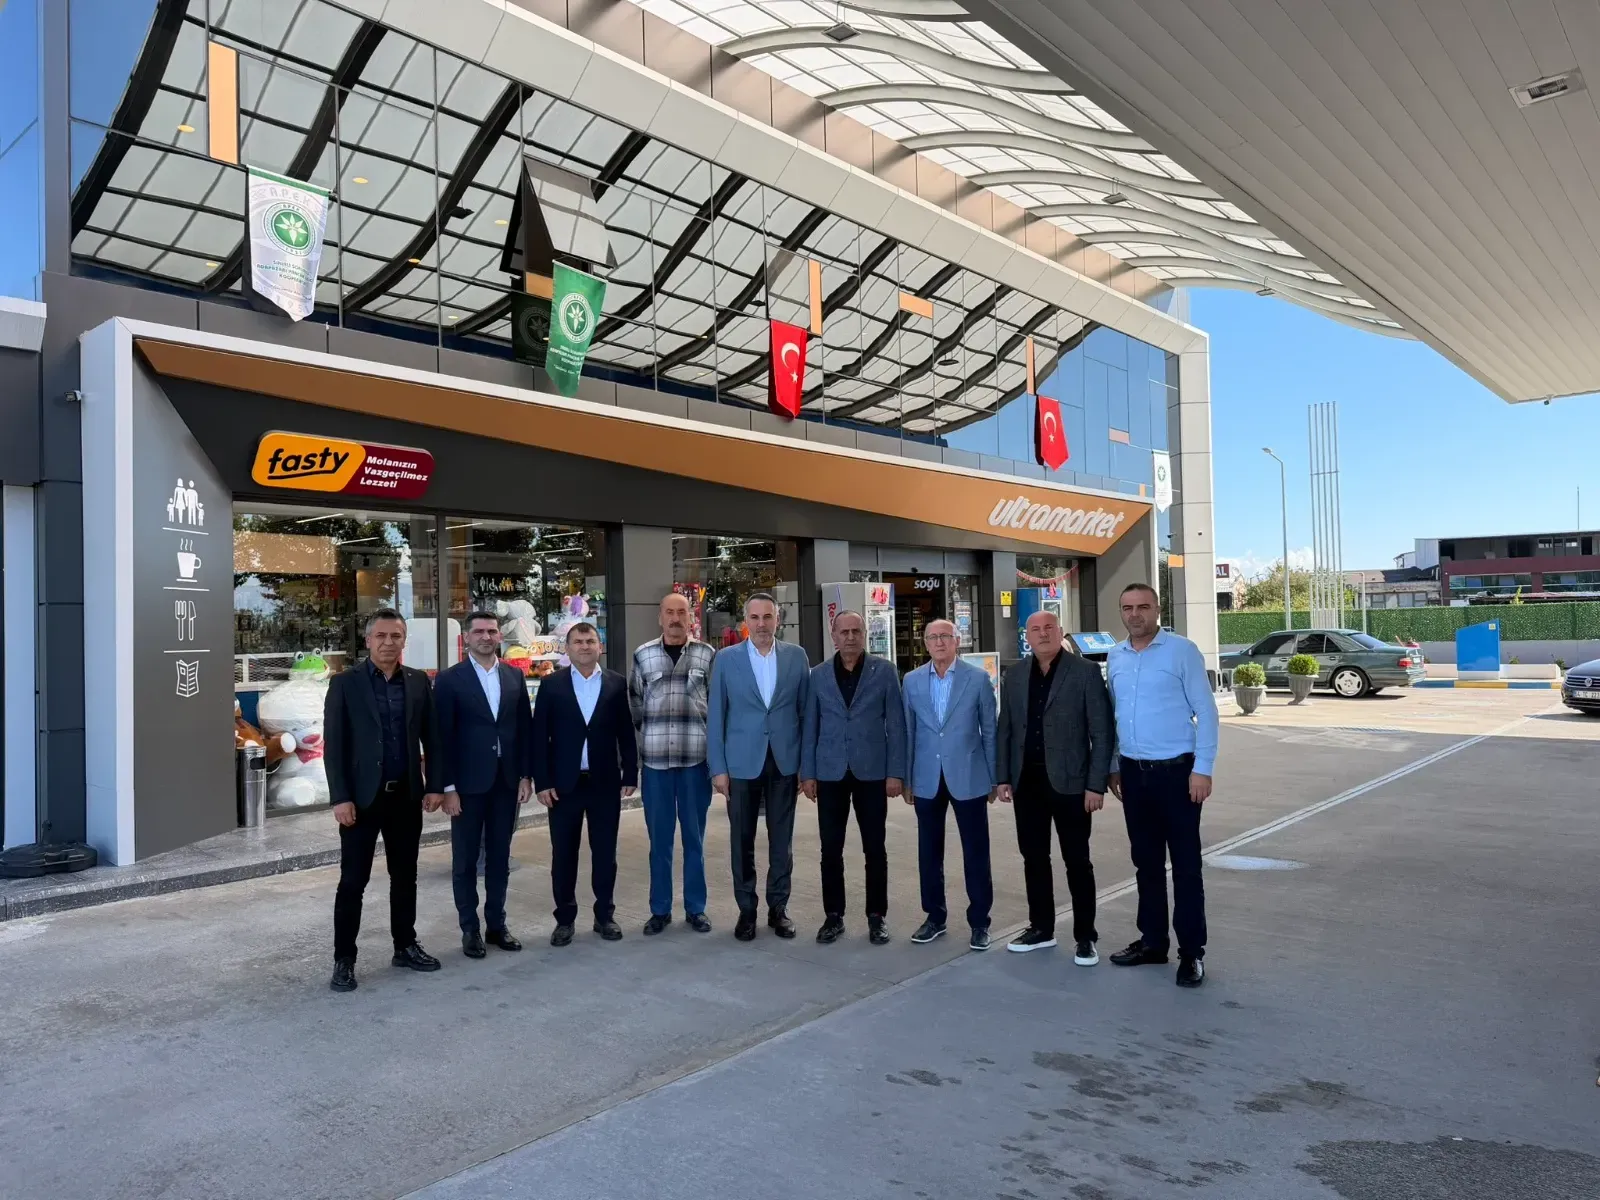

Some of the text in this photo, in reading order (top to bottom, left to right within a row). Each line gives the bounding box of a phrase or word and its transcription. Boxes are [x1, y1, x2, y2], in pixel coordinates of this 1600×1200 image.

[267, 447, 350, 480] fasty
[366, 455, 418, 470] Molanızın
[364, 466, 428, 482] Vazgeçilmez
[360, 477, 398, 489] Lezzeti
[988, 495, 1125, 539] ultramarket
